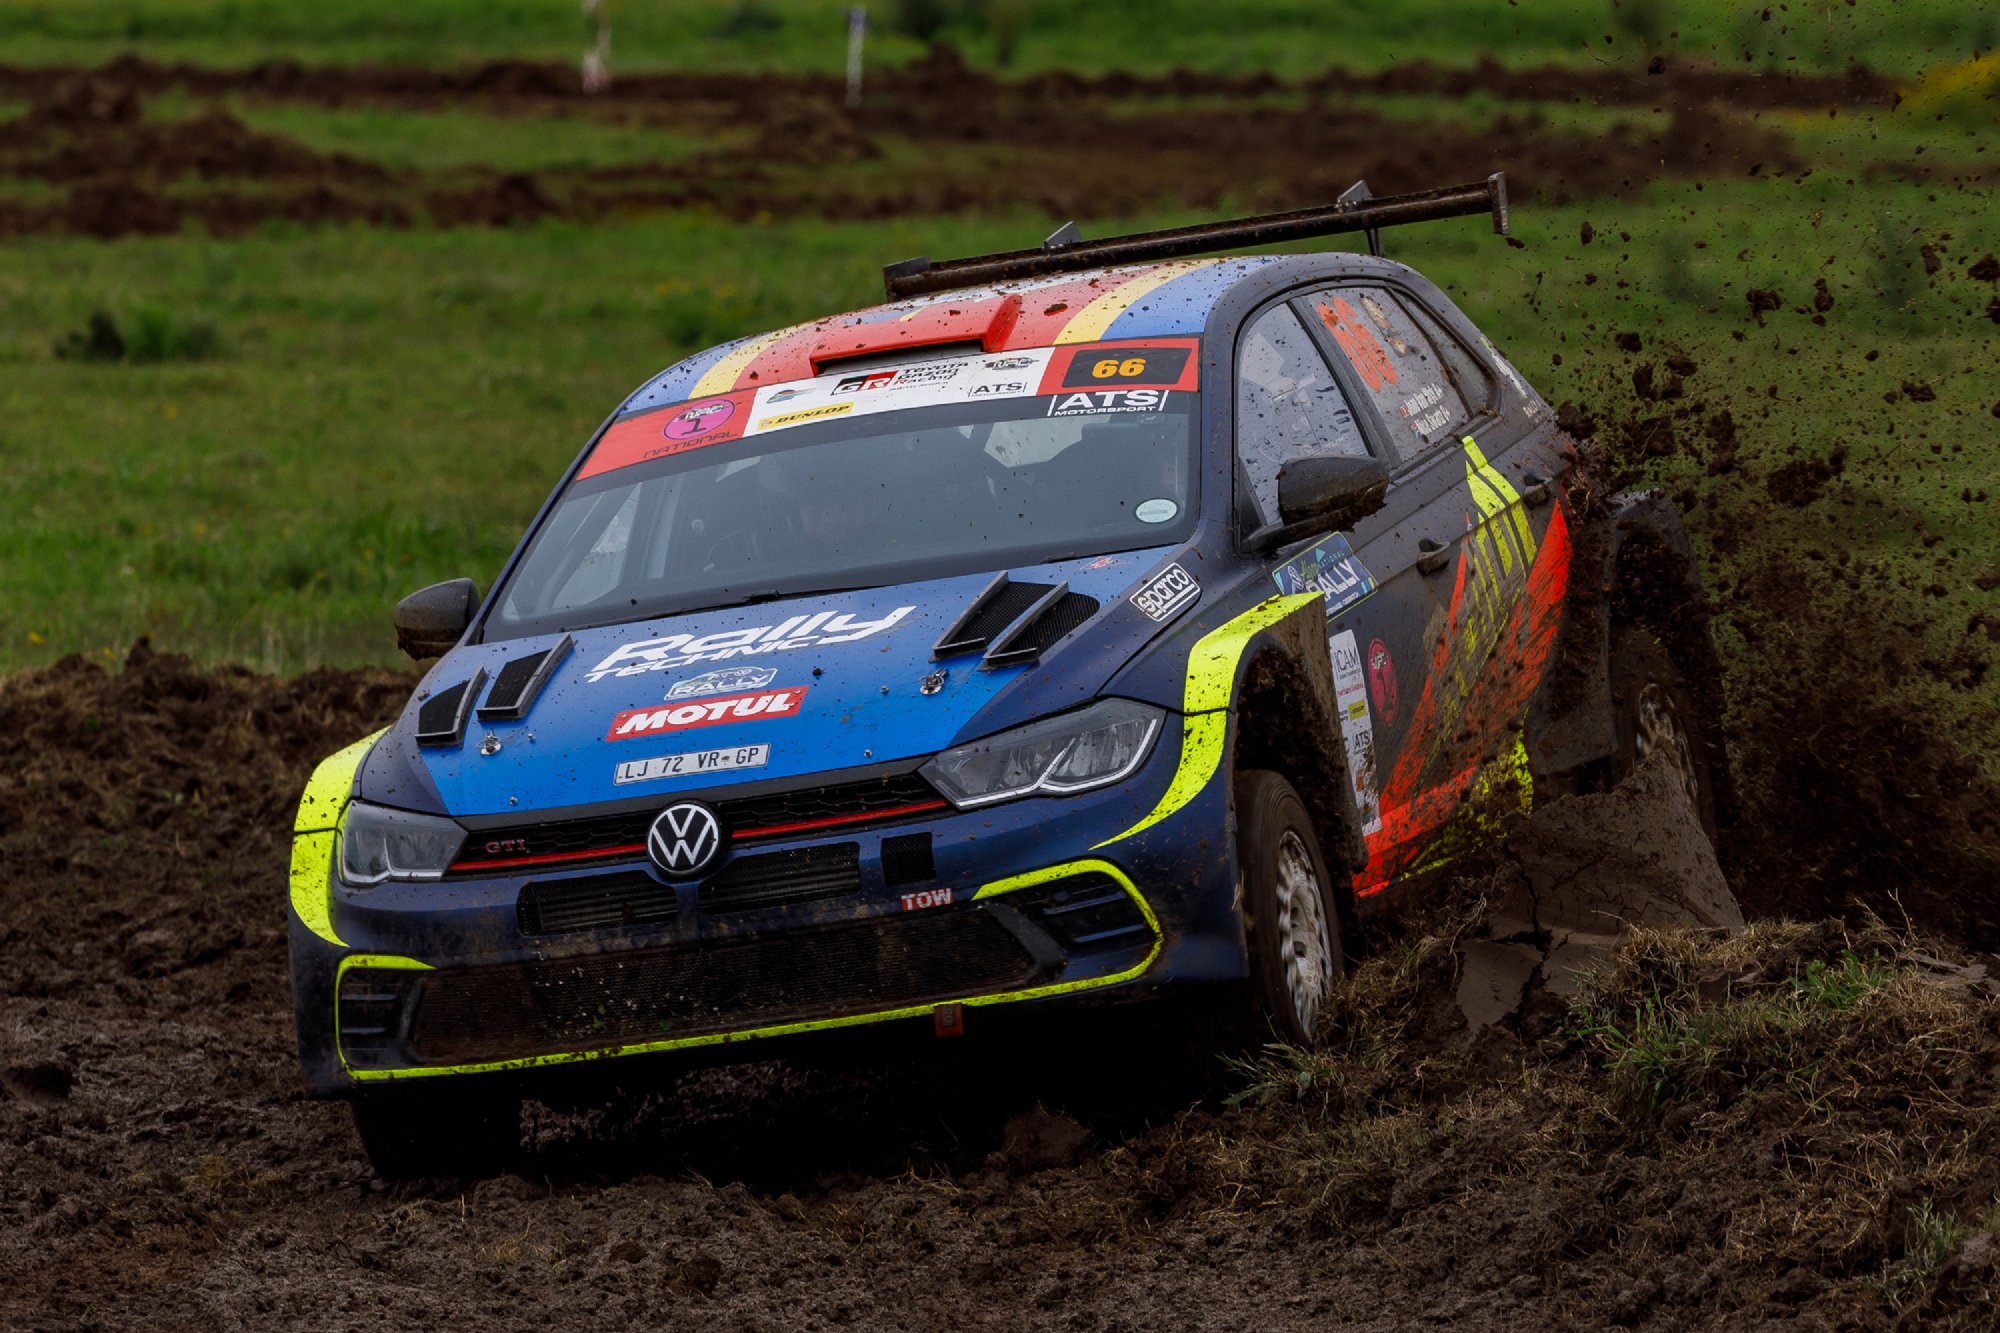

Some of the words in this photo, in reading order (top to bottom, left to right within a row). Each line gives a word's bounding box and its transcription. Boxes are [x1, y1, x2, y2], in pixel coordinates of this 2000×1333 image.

[903, 362, 968, 374] TOYOTA
[1091, 357, 1147, 378] 66
[833, 373, 895, 394] GR
[973, 382, 1023, 394] ATS
[1057, 389, 1160, 410] ATS
[775, 405, 850, 423] DUNLOP
[1054, 405, 1157, 416] MOTORSPORT
[681, 418, 707, 435] 1
[643, 430, 739, 458] NATIONAL
[590, 605, 918, 674] Rally
[584, 635, 820, 683] TECHNIC
[616, 691, 796, 735] MOTUL
[1353, 730, 1371, 750] ATS
[624, 760, 650, 780] LJ
[662, 756, 683, 774] 72
[698, 752, 721, 769] VR
[735, 747, 760, 764] GP
[485, 839, 527, 853] GTI
[901, 888, 952, 911] TOW
